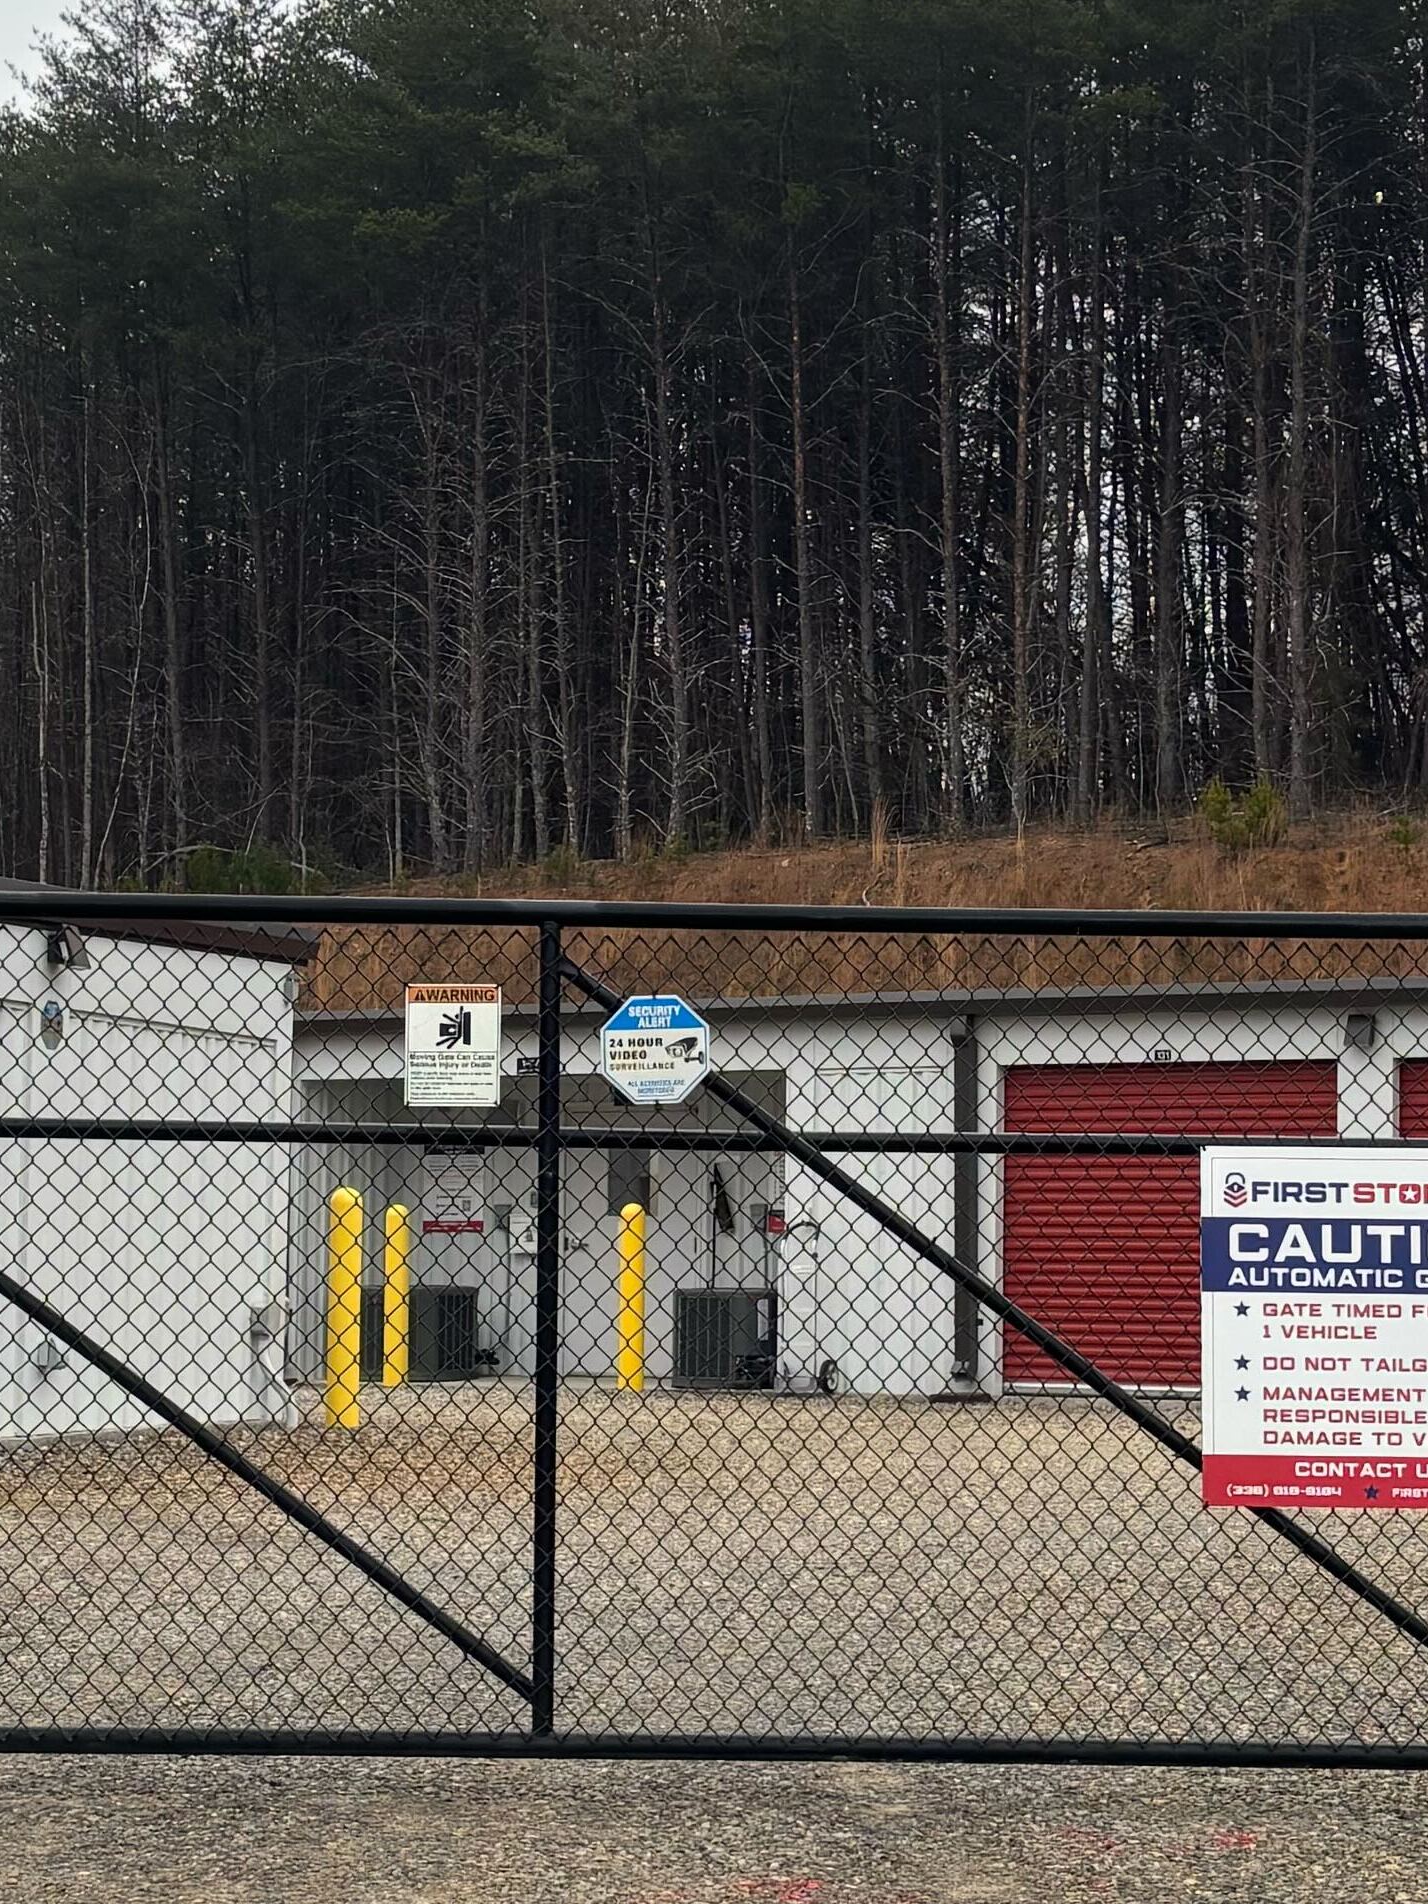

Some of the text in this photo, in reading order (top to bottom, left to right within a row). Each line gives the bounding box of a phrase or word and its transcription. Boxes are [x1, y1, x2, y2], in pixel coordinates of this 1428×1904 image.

[426, 989, 495, 1001] WARNING
[628, 1005, 681, 1017] SECURITY
[638, 1016, 671, 1028] ALERT
[609, 1037, 663, 1047] 24 HOUR
[609, 1050, 647, 1060] VIDEO
[609, 1062, 675, 1071] SURVEILLANCE
[1229, 1267, 1403, 1287] AUTOMATIC
[1263, 1303, 1321, 1316] GATE
[1332, 1304, 1401, 1318] TIMED
[1263, 1325, 1376, 1339] 1 VEHICLE
[1264, 1357, 1294, 1370] DO
[1305, 1357, 1351, 1371] NOT
[1264, 1387, 1426, 1402] MANAGEMENT
[1264, 1409, 1427, 1424] RESPONSIBLE
[1264, 1431, 1362, 1445] DAMAGE
[1372, 1432, 1402, 1445] TO
[1295, 1462, 1407, 1477] CONTACT
